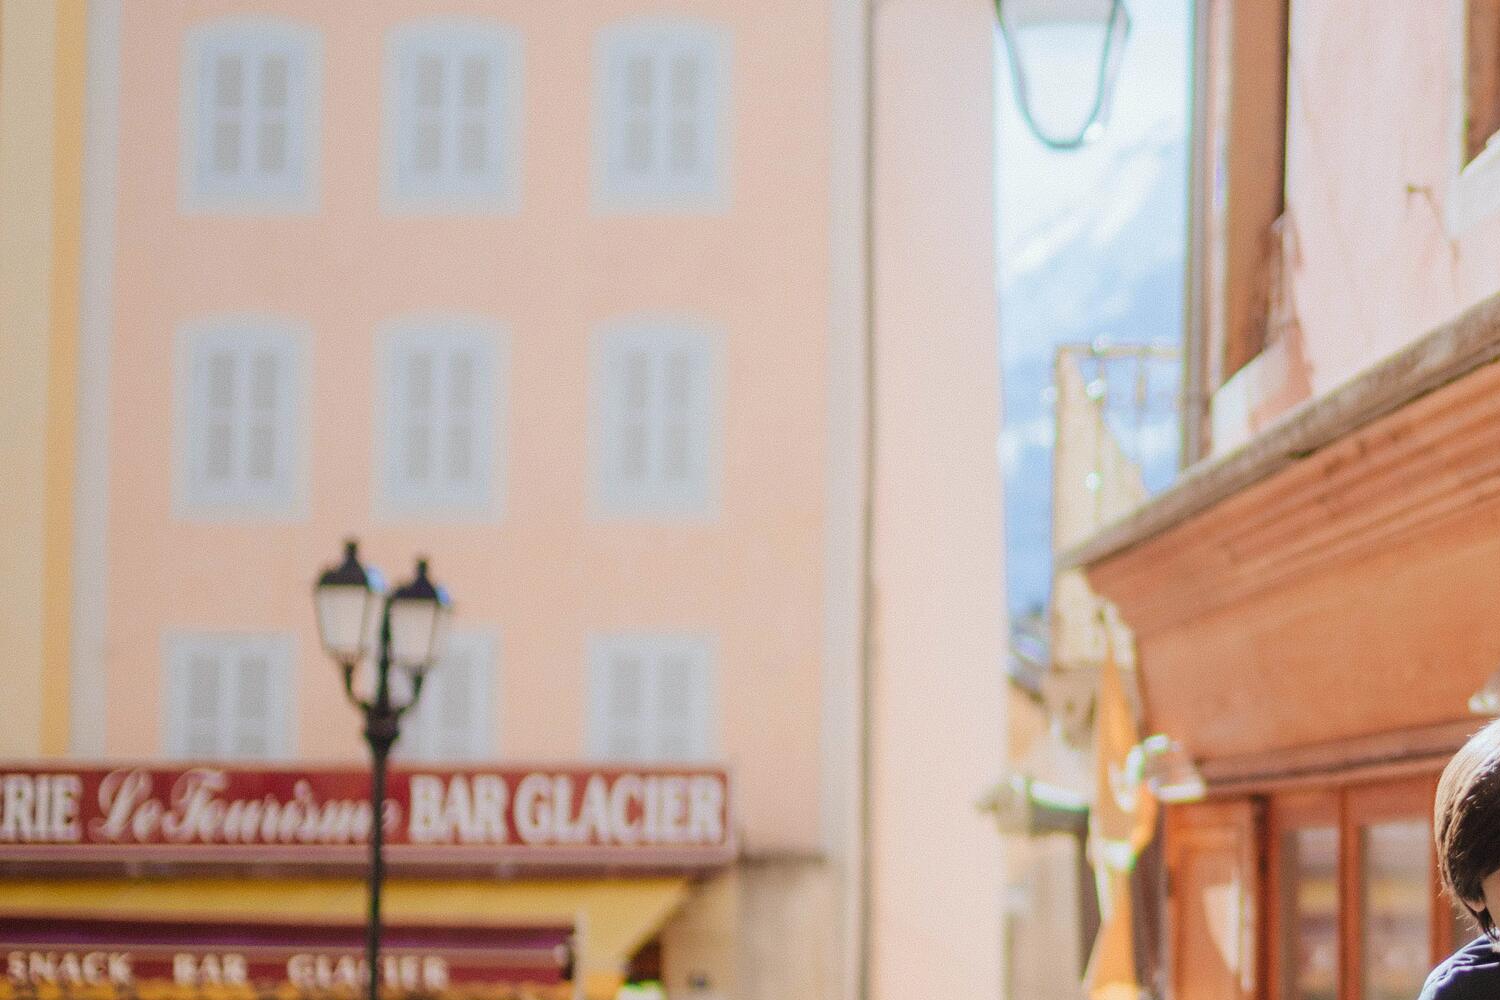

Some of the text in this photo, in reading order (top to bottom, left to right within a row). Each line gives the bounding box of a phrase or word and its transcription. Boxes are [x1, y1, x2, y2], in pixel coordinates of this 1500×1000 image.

[88, 768, 163, 843] Le
[408, 774, 507, 842] BAR
[513, 773, 724, 844] GLACIER
[7, 951, 132, 987] SNACK
[173, 952, 247, 988] BAR
